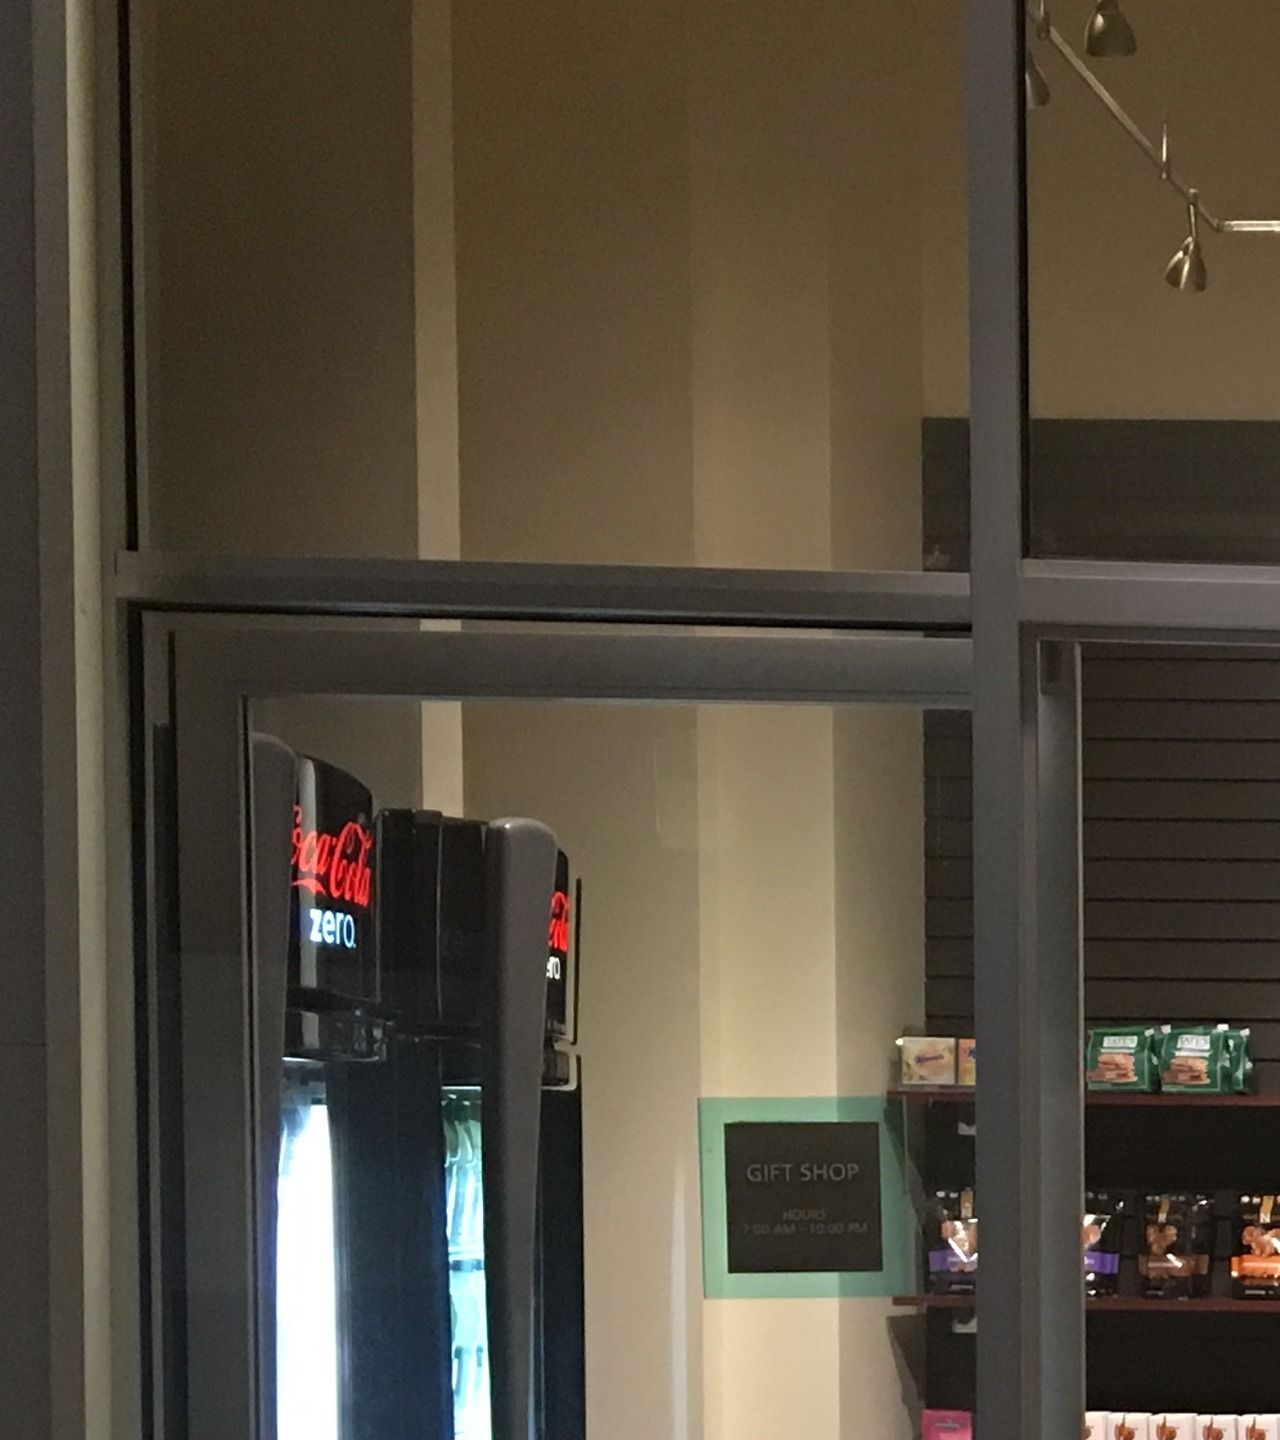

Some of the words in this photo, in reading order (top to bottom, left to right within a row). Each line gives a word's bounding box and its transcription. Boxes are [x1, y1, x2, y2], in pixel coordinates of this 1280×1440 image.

[746, 1163, 793, 1182] GIFT
[800, 1162, 860, 1182] SHOP
[783, 1209, 827, 1221] HOURS
